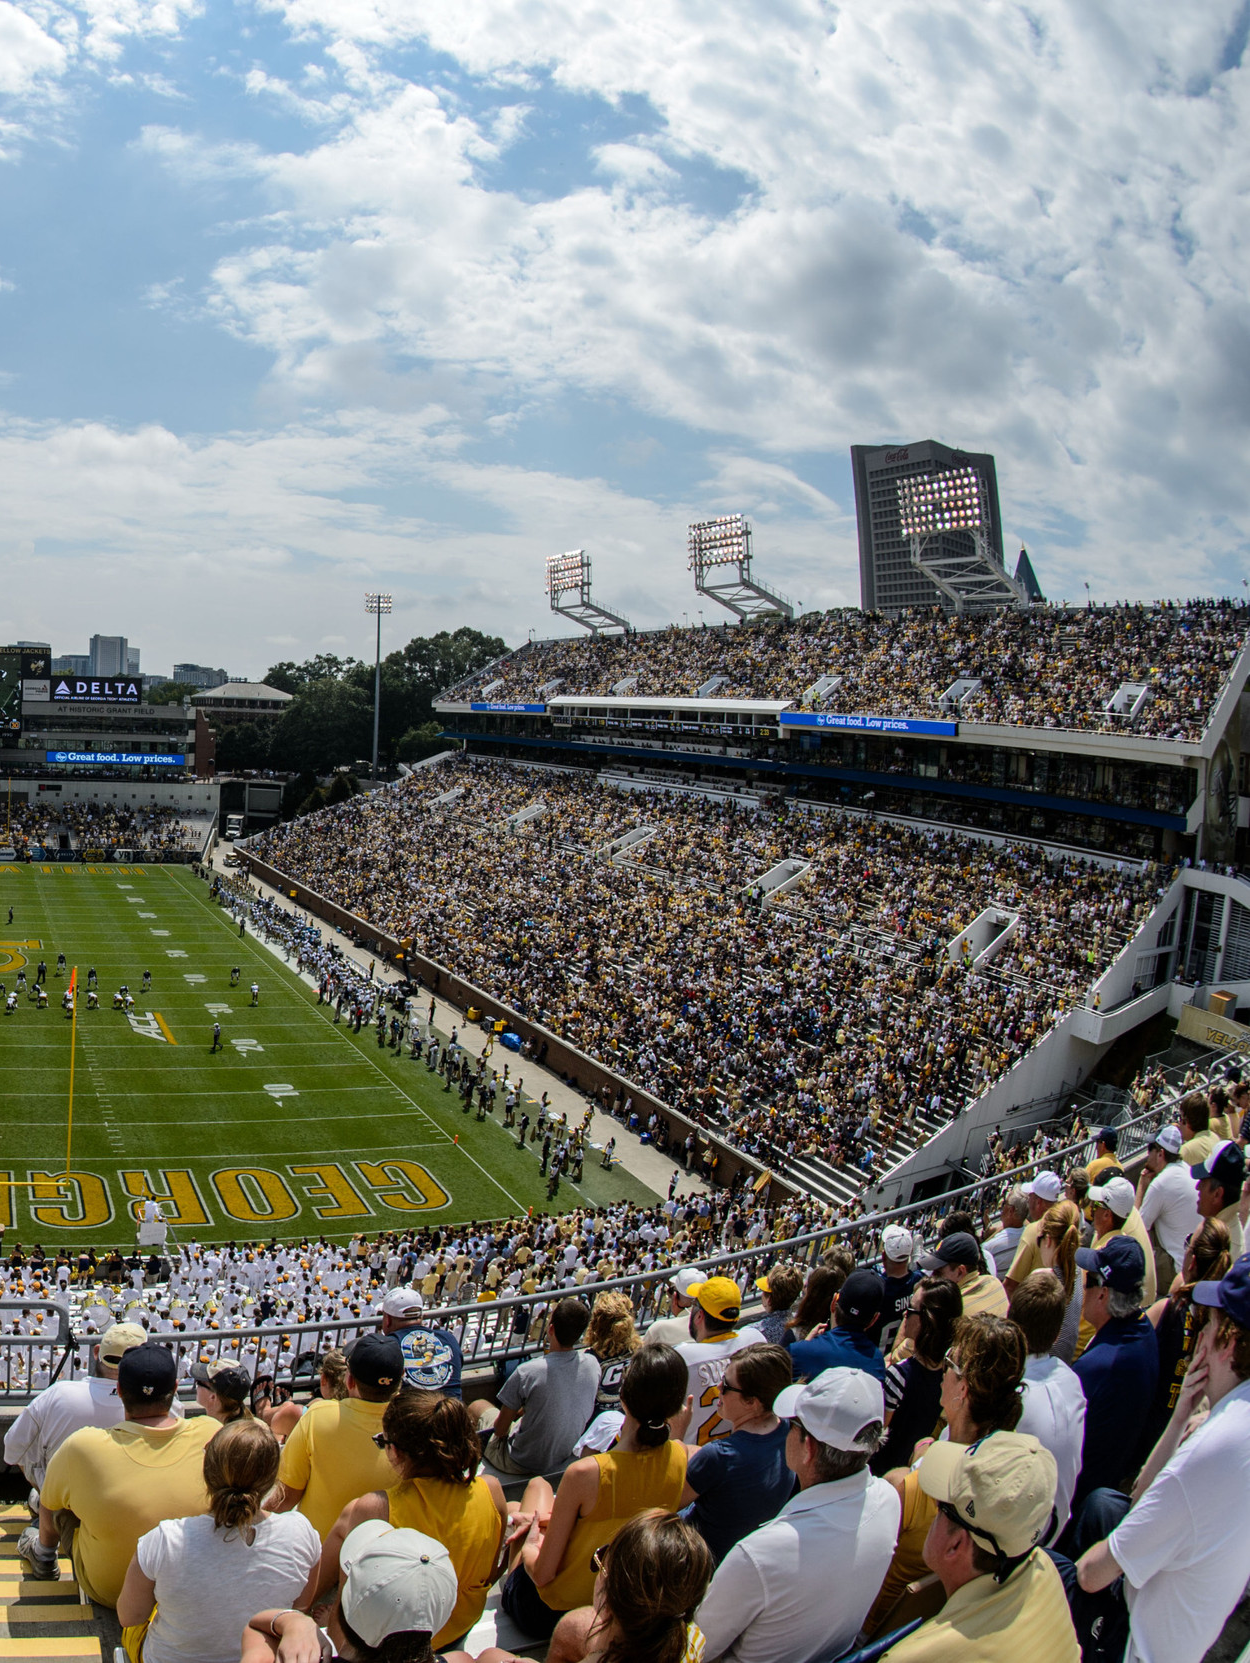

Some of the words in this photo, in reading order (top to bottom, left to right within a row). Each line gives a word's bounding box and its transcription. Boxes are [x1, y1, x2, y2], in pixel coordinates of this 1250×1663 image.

[885, 448, 909, 464] Coca-Cola
[76, 682, 137, 695] DELTA
[826, 715, 846, 725] Great
[847, 716, 864, 726] food.
[866, 717, 881, 728] Low
[882, 719, 909, 730] prices.
[68, 752, 94, 761] Great
[96, 753, 119, 762] food.
[121, 754, 141, 762] Low
[143, 754, 175, 764] prices.
[33, 865, 149, 876] TECH
[204, 1003, 233, 1013] 30
[127, 1011, 168, 1043] ACC
[231, 1039, 265, 1052] 20
[1206, 1028, 1250, 1054] YELLO
[263, 1083, 299, 1097] 10
